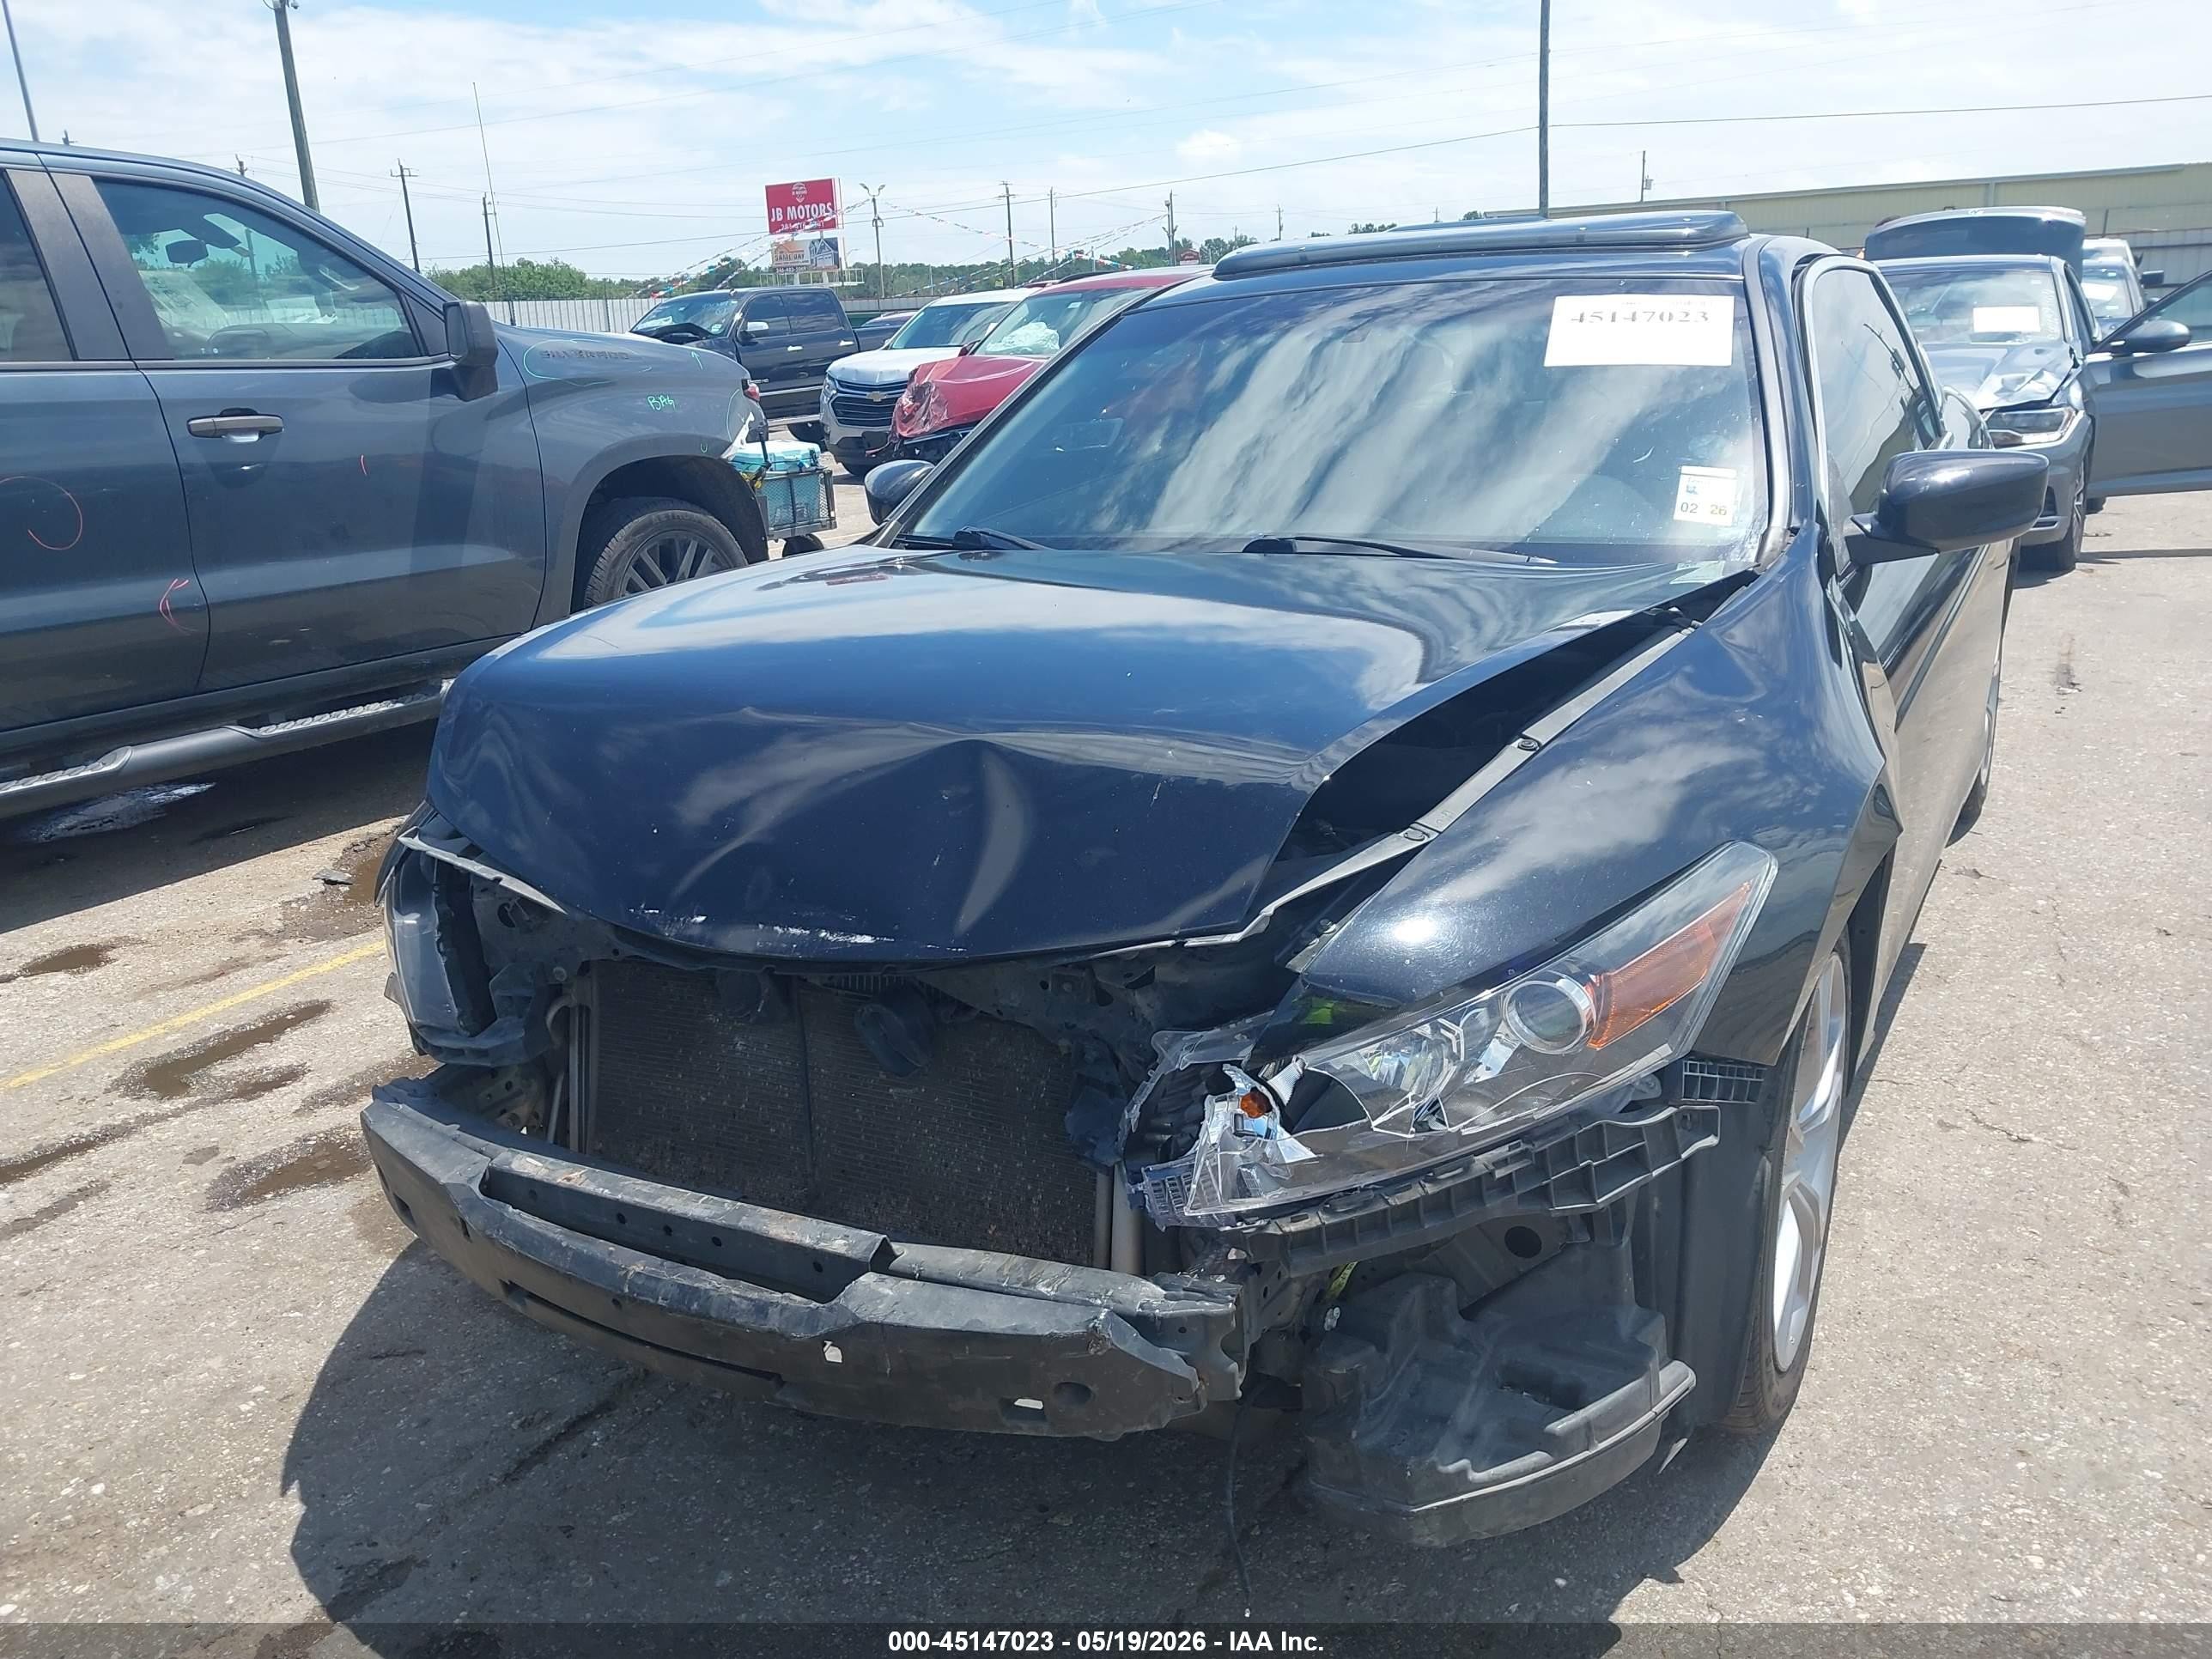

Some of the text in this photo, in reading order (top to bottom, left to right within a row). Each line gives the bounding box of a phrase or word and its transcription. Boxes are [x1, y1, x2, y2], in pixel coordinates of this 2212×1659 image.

[770, 202, 833, 222] JB MOTORS
[1571, 310, 1710, 324] 45147023
[539, 349, 630, 360] SILVERADO
[1680, 501, 1728, 516] 02 26
